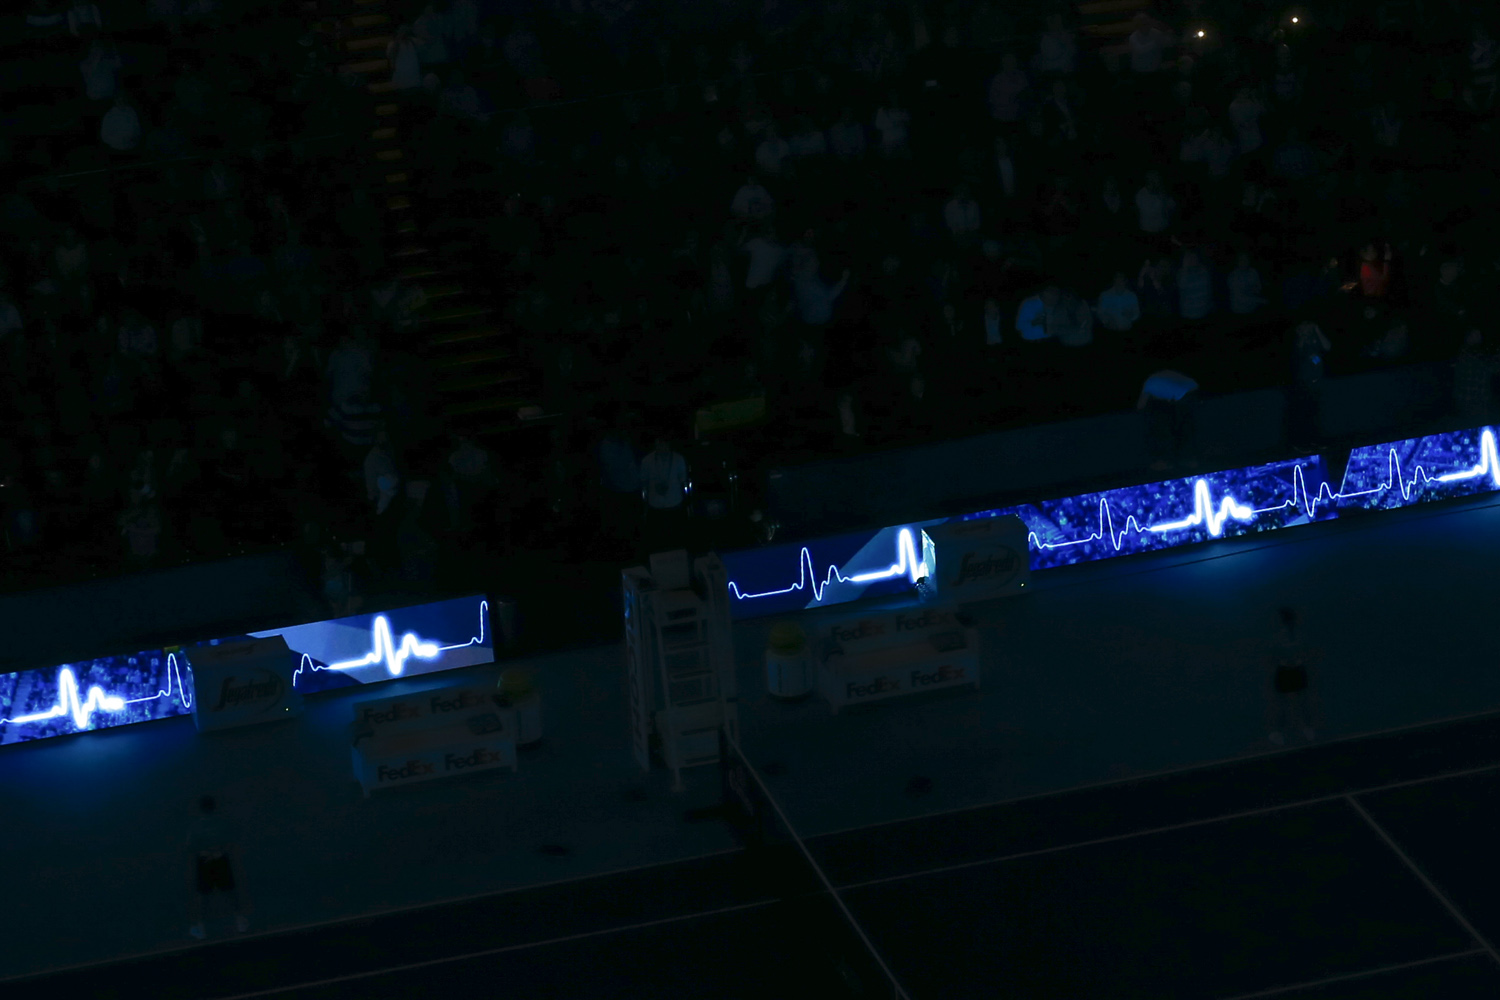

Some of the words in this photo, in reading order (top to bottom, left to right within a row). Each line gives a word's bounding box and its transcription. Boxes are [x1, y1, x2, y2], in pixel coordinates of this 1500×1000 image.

[831, 620, 886, 642] FedEx
[895, 609, 951, 632] FedEx
[846, 675, 901, 699] FedEx
[910, 665, 966, 688] FedEx
[363, 702, 420, 724] FedEx
[430, 690, 485, 714] FedEx
[377, 759, 435, 782] FedEx
[445, 747, 501, 771] FedEx
